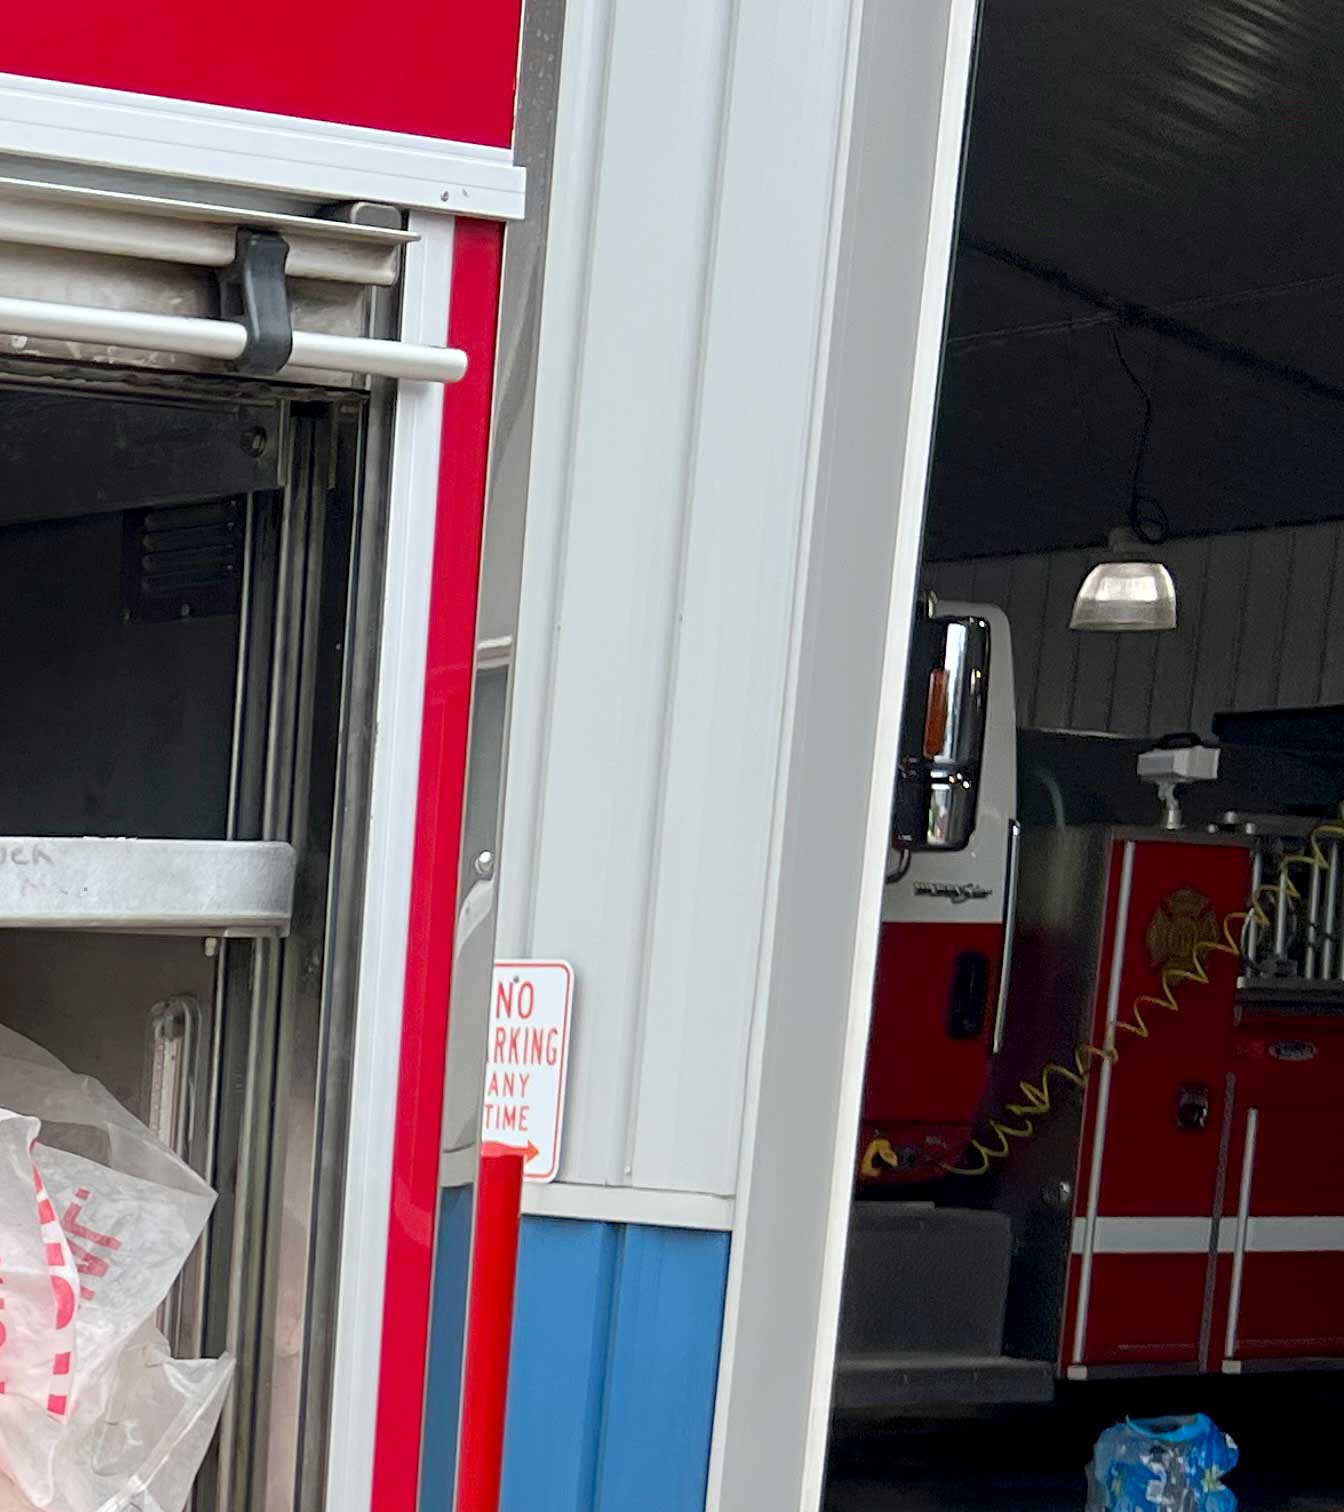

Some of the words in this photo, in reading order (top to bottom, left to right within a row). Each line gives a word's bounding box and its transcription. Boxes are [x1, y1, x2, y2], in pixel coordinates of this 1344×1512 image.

[495, 981, 535, 1019] NO
[486, 1026, 560, 1066] RKING
[487, 1071, 531, 1098] ANY
[485, 1104, 530, 1132] TIME
